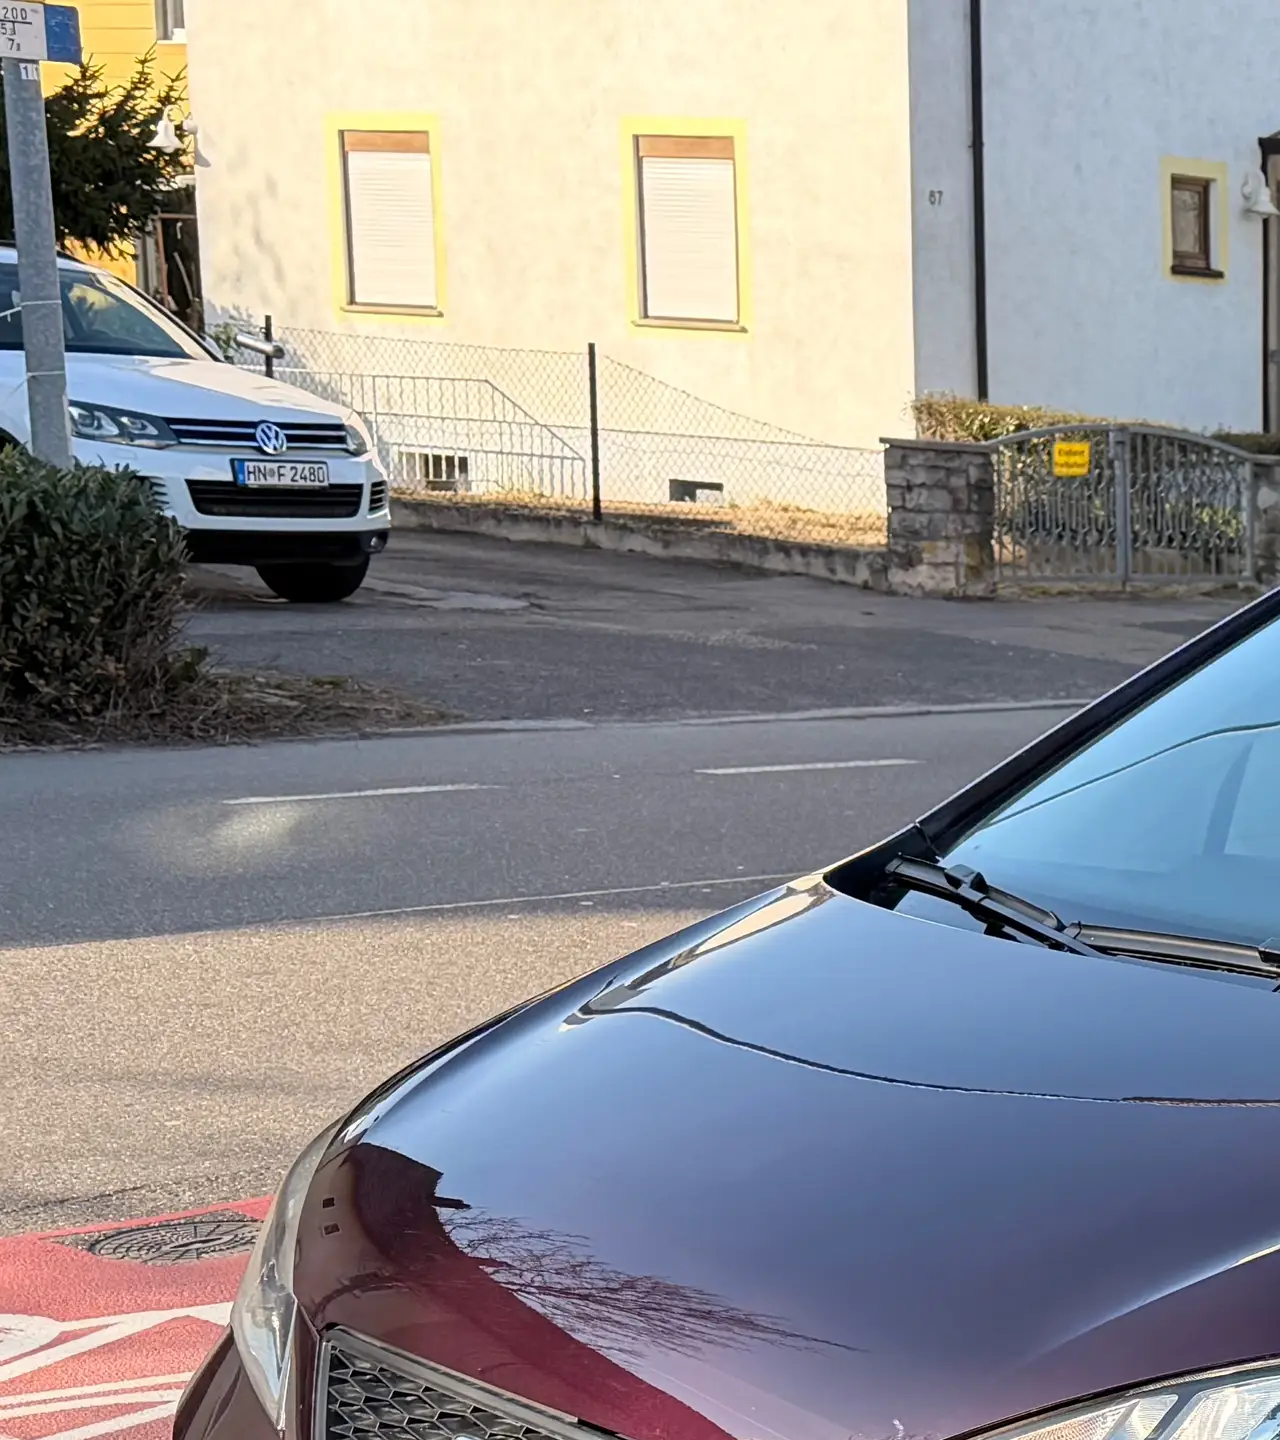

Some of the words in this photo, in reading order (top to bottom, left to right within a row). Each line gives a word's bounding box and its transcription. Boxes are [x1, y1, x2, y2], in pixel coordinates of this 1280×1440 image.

[247, 464, 267, 481] HN
[277, 465, 286, 482] F
[290, 466, 325, 483] 2480
